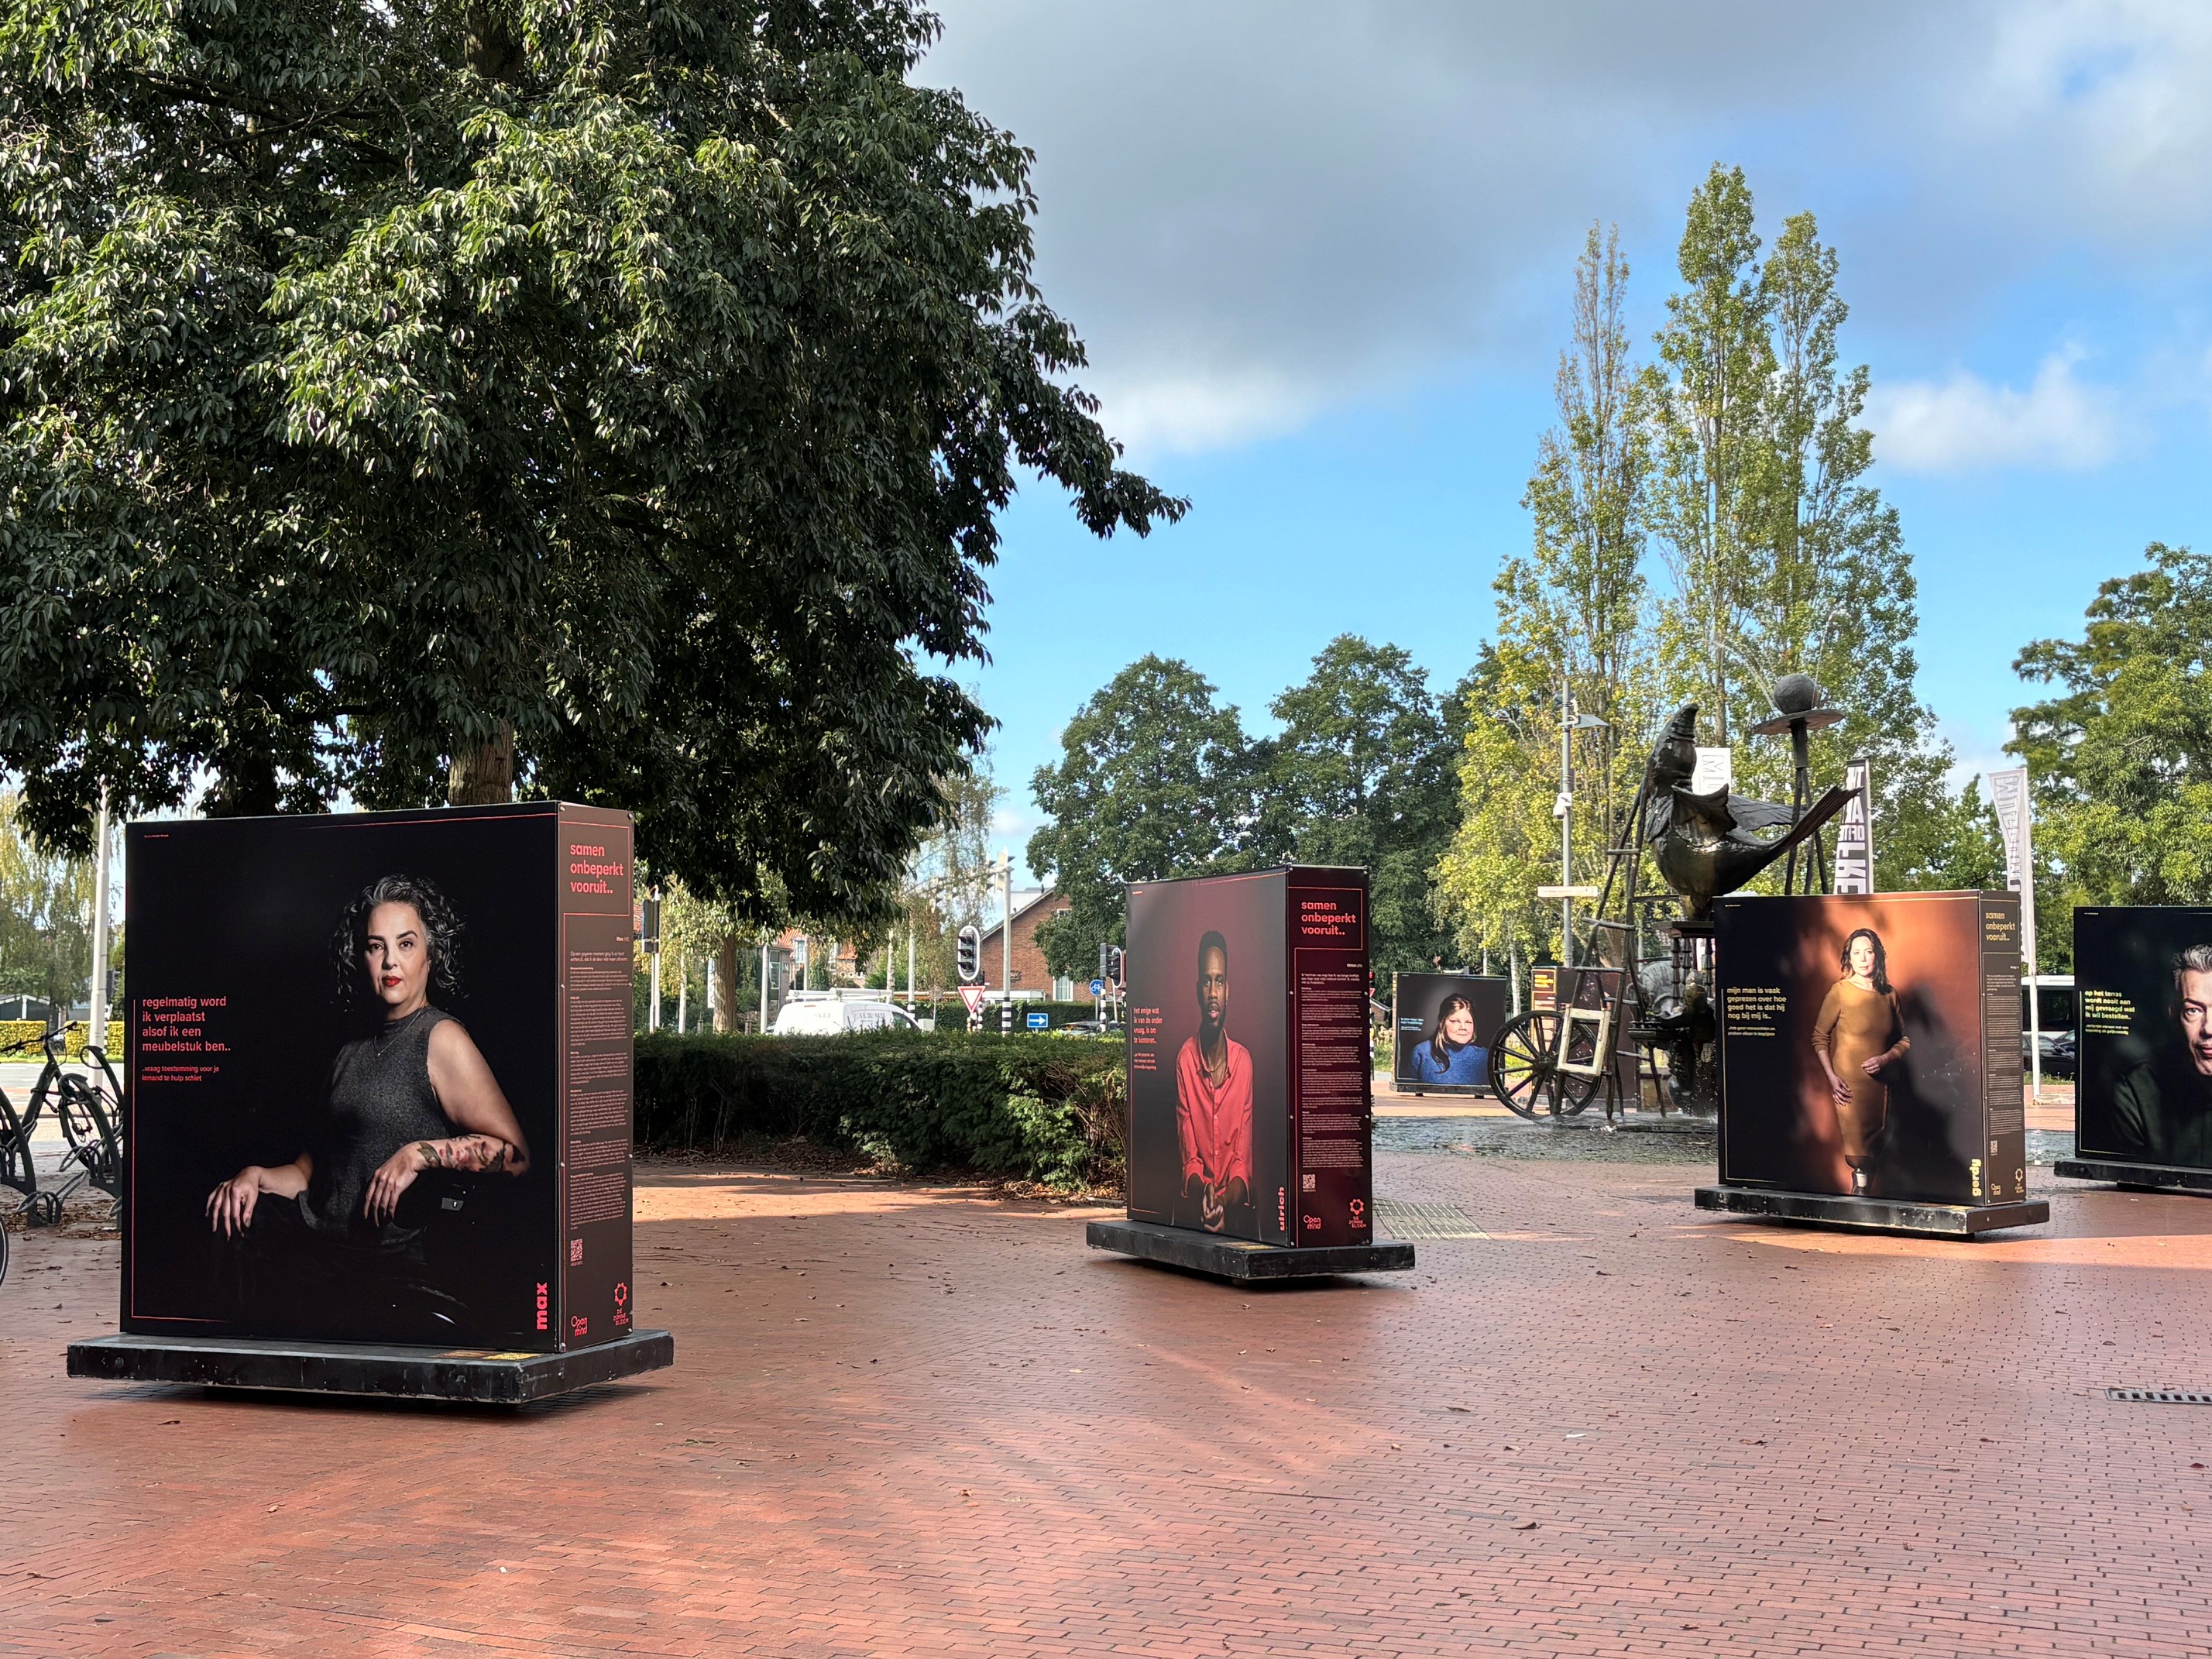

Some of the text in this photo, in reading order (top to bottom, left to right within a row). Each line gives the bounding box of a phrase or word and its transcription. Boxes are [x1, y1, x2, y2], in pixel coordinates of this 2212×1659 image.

[570, 843, 605, 857] samen
[570, 861, 624, 878] onbeperkt
[570, 879, 613, 894] vooruit..
[1301, 902, 1337, 910] samen
[1301, 912, 1356, 925] onbeperkt
[1301, 925, 1345, 936] vooruit..
[1985, 921, 2015, 932] onbeperkt
[143, 996, 226, 1010] regelmatig word
[1776, 1004, 1785, 1012] hij
[143, 1011, 205, 1024] ik verplaatst
[143, 1025, 201, 1036] alsof ik een
[143, 1041, 231, 1051] meubelstuk ben..
[161, 1065, 199, 1073] toestemming
[213, 1065, 219, 1073] je
[171, 1074, 184, 1083] hulp
[537, 1282, 548, 1330] max
